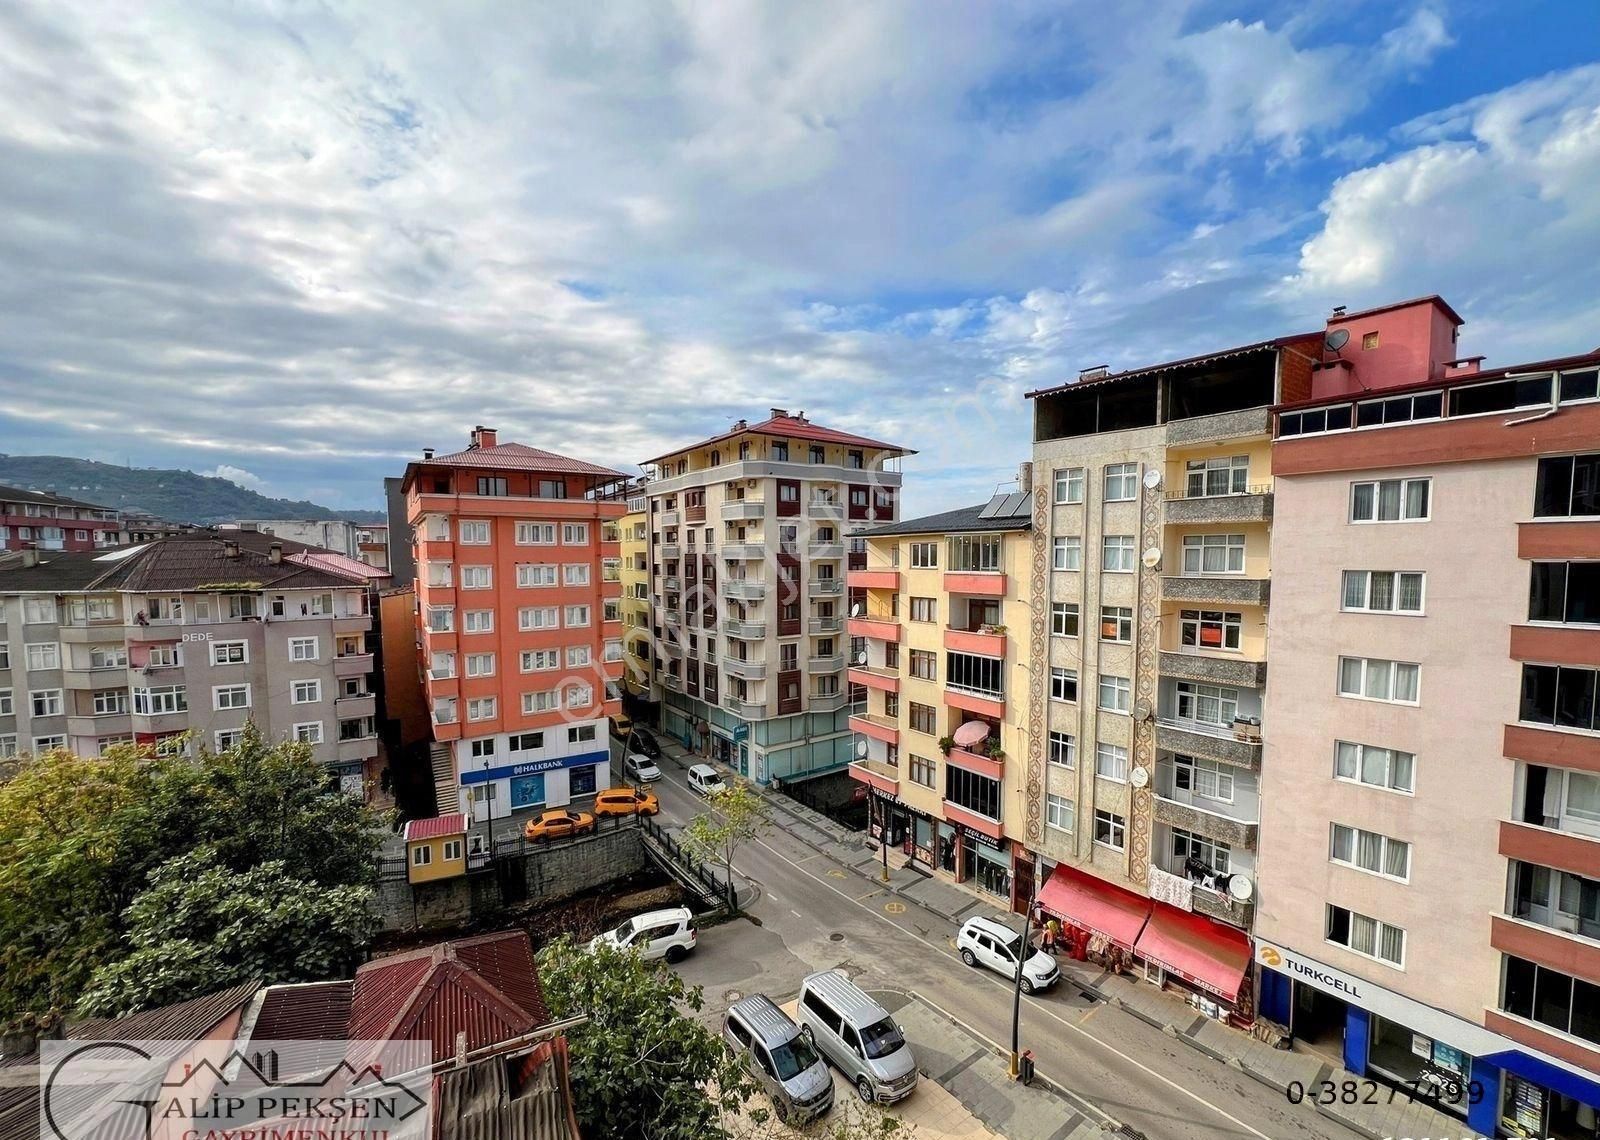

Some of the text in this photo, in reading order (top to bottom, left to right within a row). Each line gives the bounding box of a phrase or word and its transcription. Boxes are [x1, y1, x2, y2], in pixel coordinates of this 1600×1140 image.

[182, 632, 214, 642] DEDE
[523, 760, 563, 774] HALKBANK
[1285, 958, 1362, 999] TURKCELL
